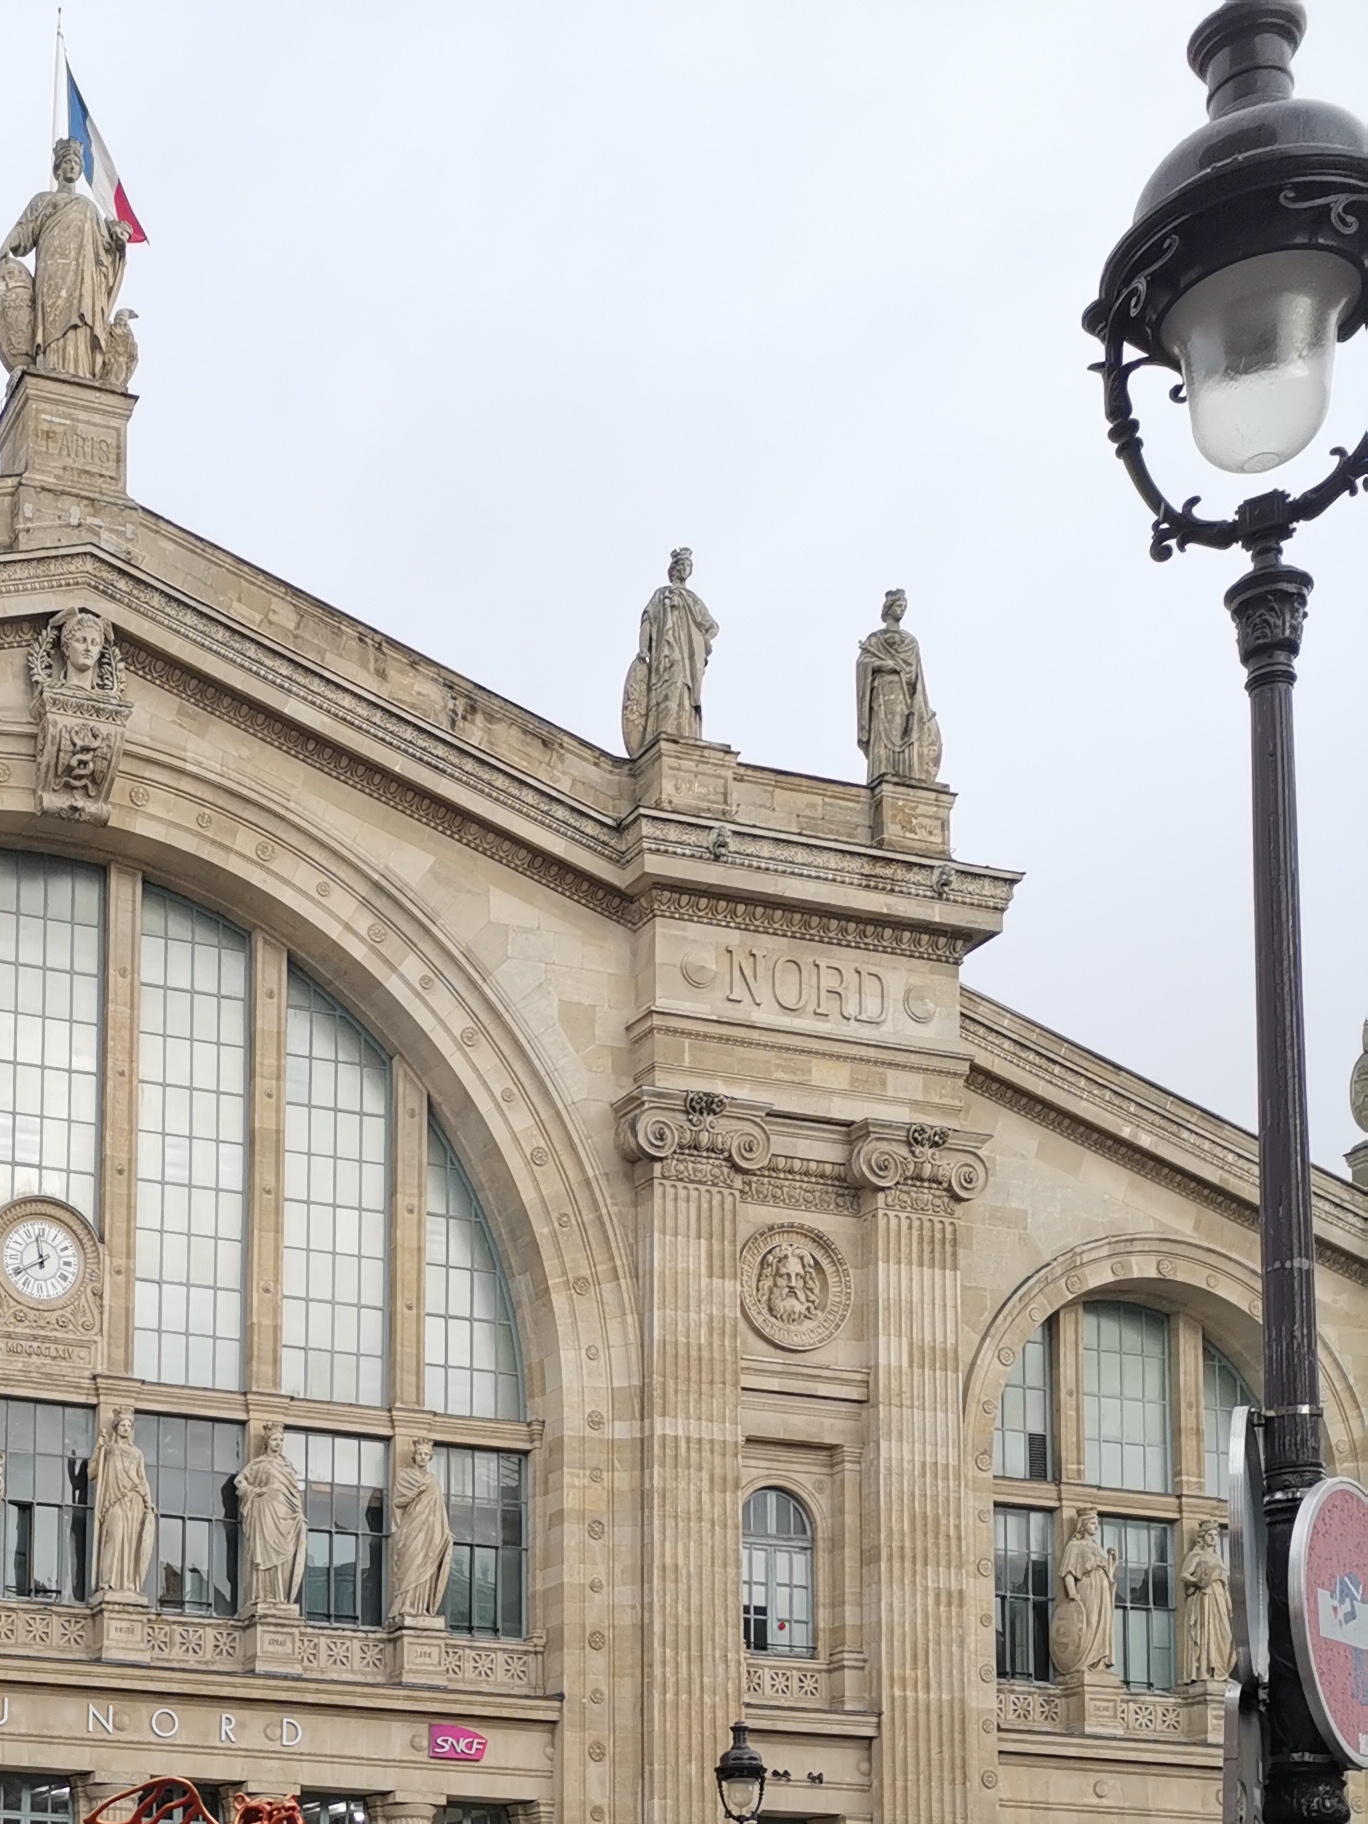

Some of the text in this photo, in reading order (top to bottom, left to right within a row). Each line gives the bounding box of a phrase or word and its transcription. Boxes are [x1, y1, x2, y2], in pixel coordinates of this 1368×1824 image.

[41, 428, 109, 464] PARIS
[726, 945, 888, 1025] NORD
[87, 1703, 303, 1747] NORD
[433, 1736, 486, 1755] SNCF
